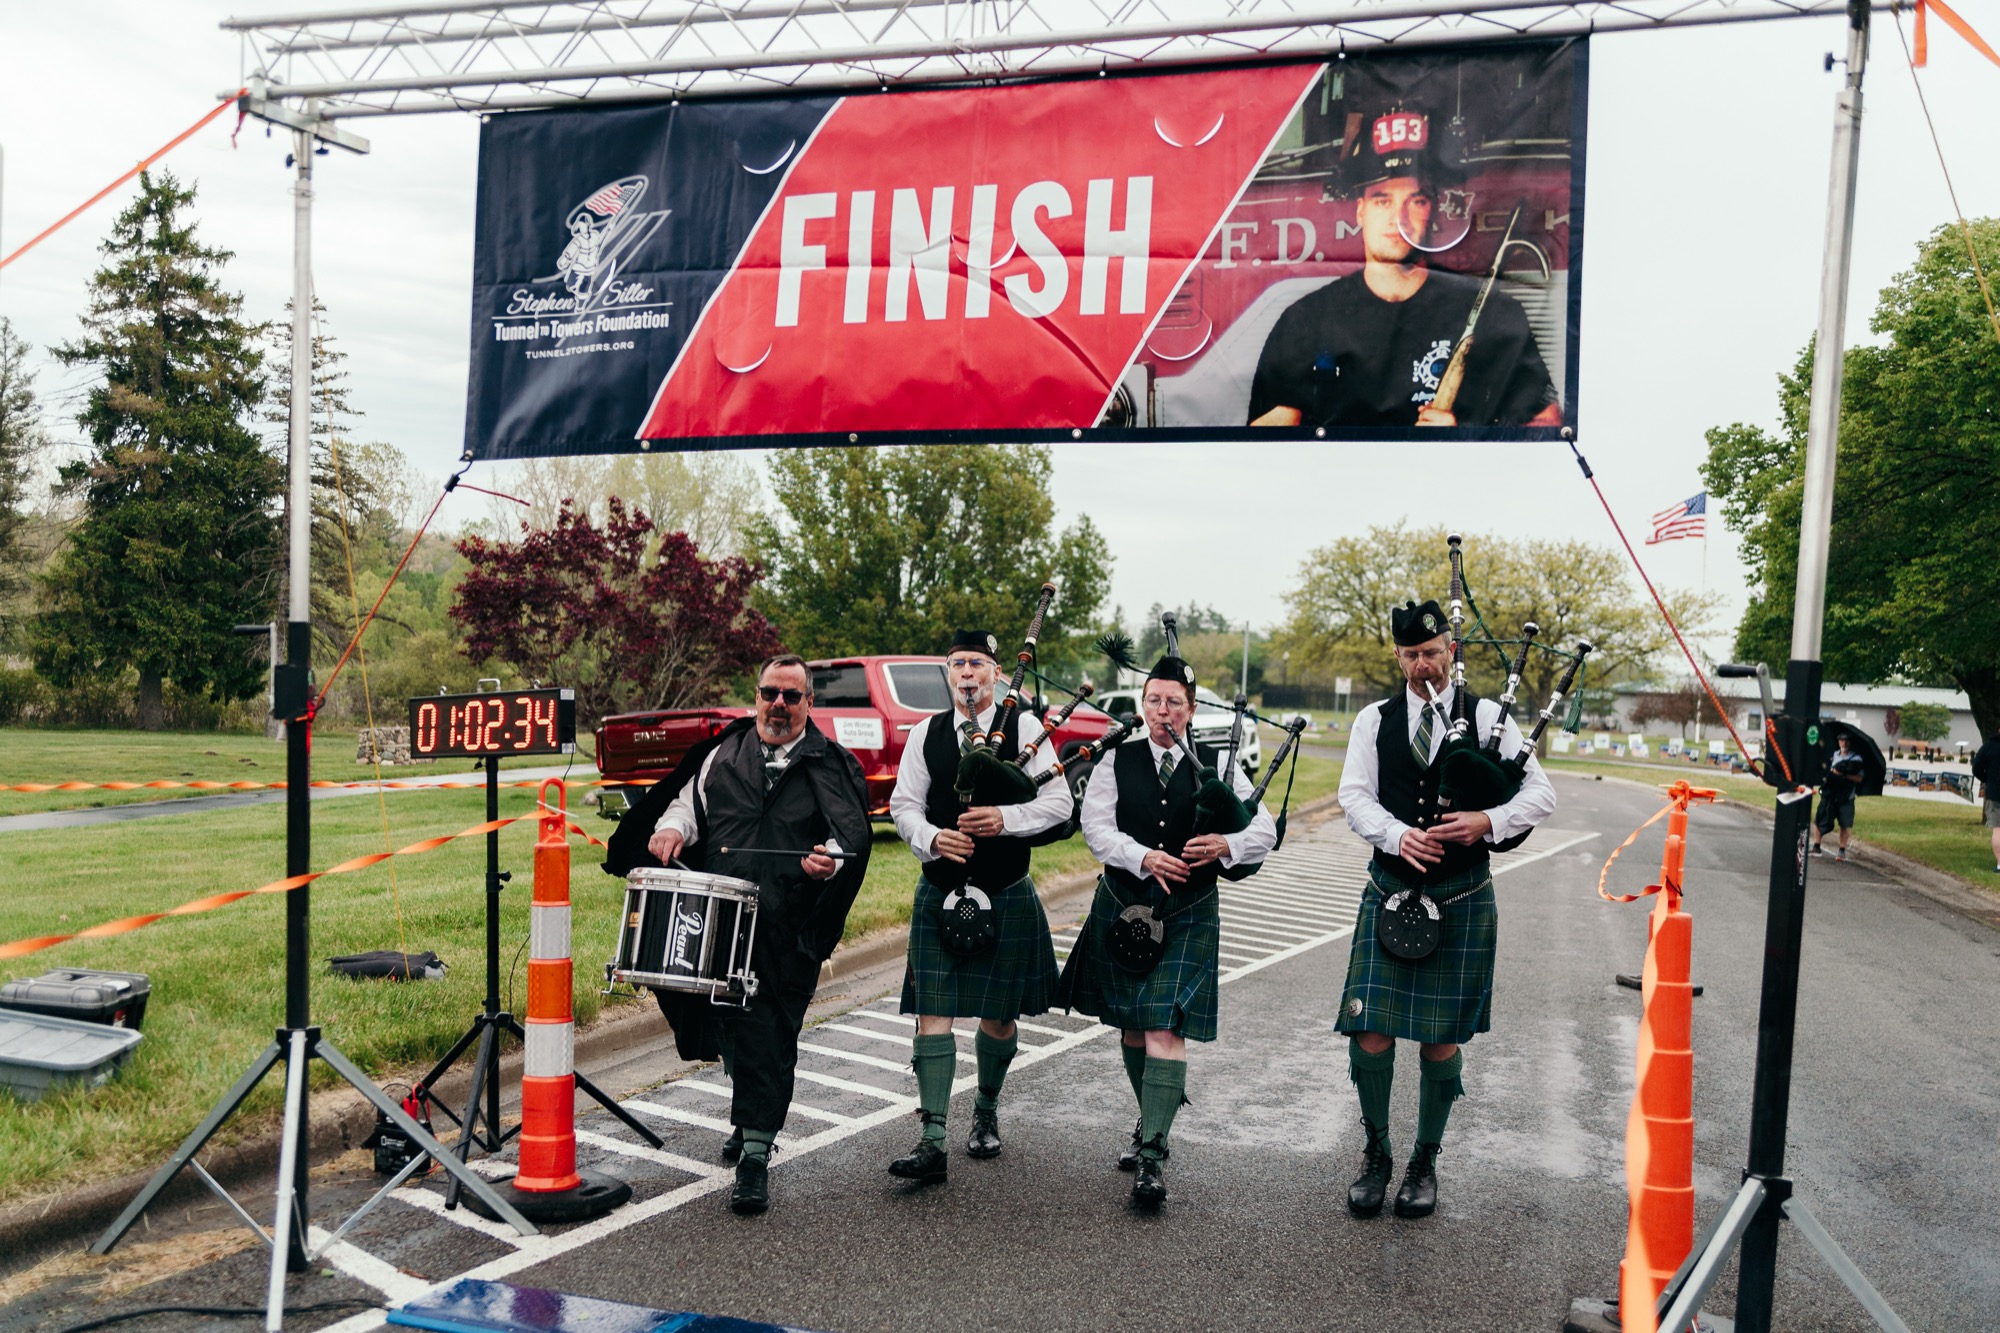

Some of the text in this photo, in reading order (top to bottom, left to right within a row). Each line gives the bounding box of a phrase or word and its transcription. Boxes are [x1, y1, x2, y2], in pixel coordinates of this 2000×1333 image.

[1377, 118, 1422, 146] 153
[775, 175, 1154, 328] FINISH
[1213, 217, 1325, 270] F.D.
[506, 280, 655, 319] Stephen Siller
[494, 321, 540, 341] Tunnel
[550, 318, 594, 339] Towers
[595, 310, 670, 334] Foundation
[525, 341, 635, 360] TUNNEL2TOWERS.ORG
[843, 729, 875, 738] Auto Group
[673, 901, 704, 971] Pearl
